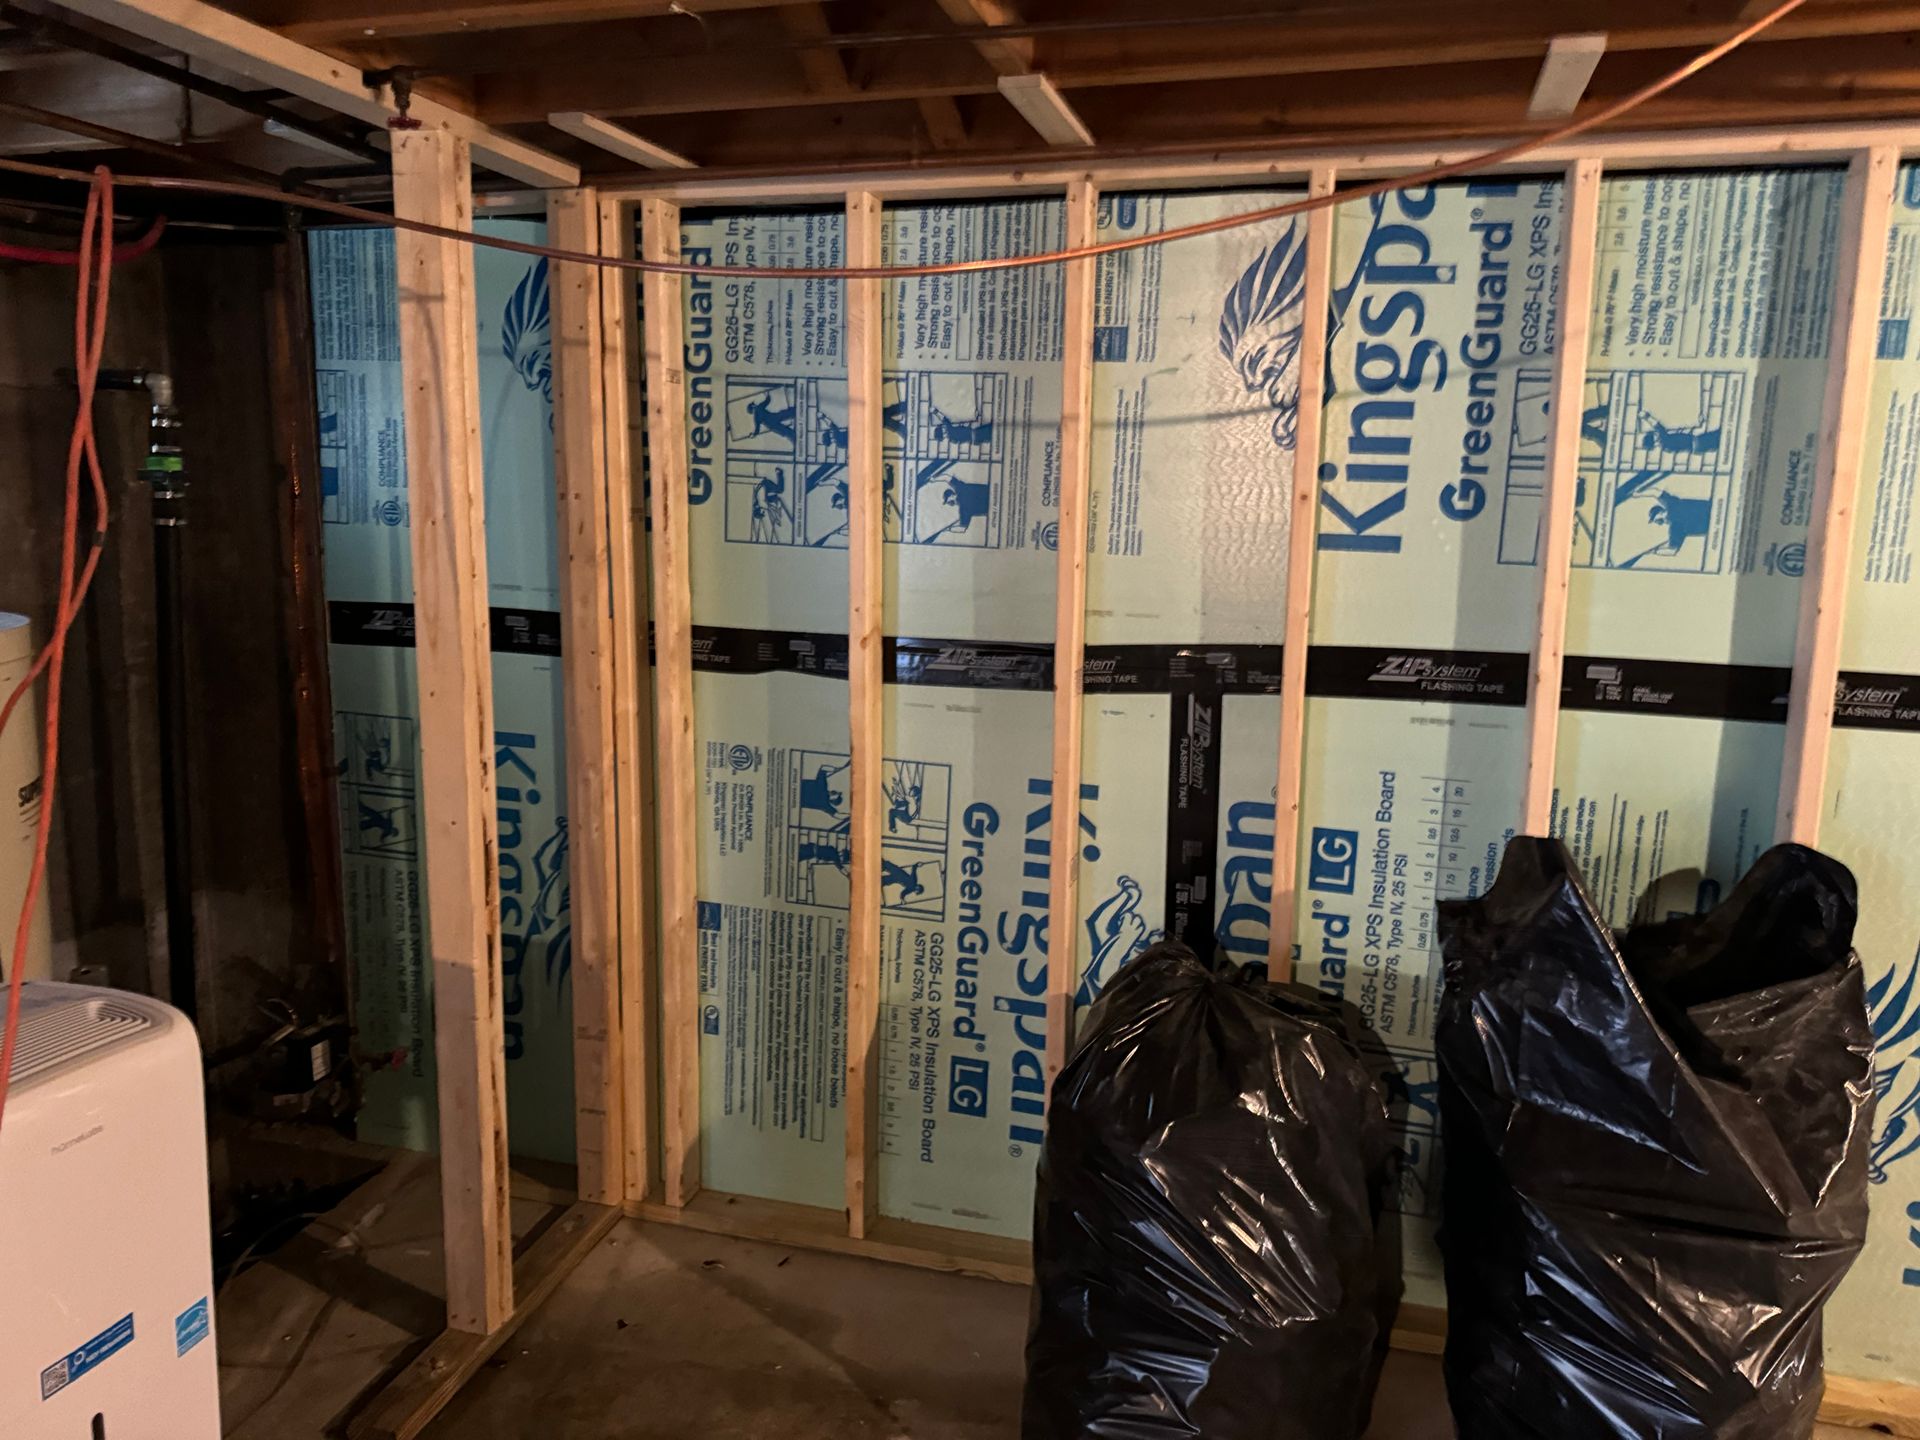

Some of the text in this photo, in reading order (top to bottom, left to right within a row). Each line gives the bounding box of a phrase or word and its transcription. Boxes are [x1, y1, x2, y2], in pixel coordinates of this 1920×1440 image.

[1657, 206, 1670, 220] to
[1528, 215, 1549, 258] XPS
[1673, 205, 1690, 251] shape,
[1635, 219, 1652, 280] moisture
[1649, 224, 1668, 295] resistance
[1671, 256, 1681, 265] &
[927, 226, 940, 348] Strong to
[942, 283, 952, 302] cut
[1667, 270, 1681, 291] cut
[744, 281, 756, 319] C578,
[815, 237, 827, 356] Strong to
[830, 290, 838, 311] cut
[916, 295, 928, 321] high
[1518, 264, 1545, 355] GG25-LG
[1629, 284, 1647, 314] high
[1664, 295, 1676, 308] to
[725, 283, 739, 363] GG25-LG
[803, 303, 815, 328] high
[829, 313, 837, 324] to
[942, 305, 951, 317] to
[1642, 300, 1661, 344] Strong
[744, 323, 755, 363] ASTM
[828, 327, 839, 357] Easy
[914, 323, 925, 349] Very
[941, 320, 952, 349] Easy
[1624, 317, 1641, 345] Very
[1658, 314, 1677, 345] Easy
[802, 331, 814, 356] Very
[1041, 441, 1053, 506] COMPLIANCE
[1115, 675, 1138, 683] TAPE
[1421, 681, 1504, 694] FLASHING TAPE
[1178, 738, 1188, 809] FLASHING TAPE
[1454, 786, 1463, 797] 20
[745, 785, 753, 841] COMPLIANCE
[1394, 854, 1408, 877] PSI
[1448, 853, 1458, 862] 10
[1392, 880, 1405, 897] 25
[1423, 871, 1433, 882] 1.5
[1446, 873, 1456, 885] 7.5
[1358, 771, 1395, 1030] GG25-LG XPS Insulation Board
[1419, 912, 1429, 928] 0.75
[833, 927, 844, 952] Easy
[913, 930, 926, 965] ASTM
[1387, 919, 1403, 950] Type
[835, 955, 844, 965] to
[1385, 954, 1400, 991] C578,
[834, 968, 843, 985] cut
[910, 969, 923, 1002] C578,
[831, 997, 841, 1030] shape,
[908, 1006, 921, 1033] Type
[1381, 994, 1397, 1034] ASTM
[831, 1032, 840, 1045] no
[920, 932, 944, 1163] GG25-LG XPS Insulation Board
[909, 1053, 920, 1068] 25
[908, 1071, 920, 1090] PSI
